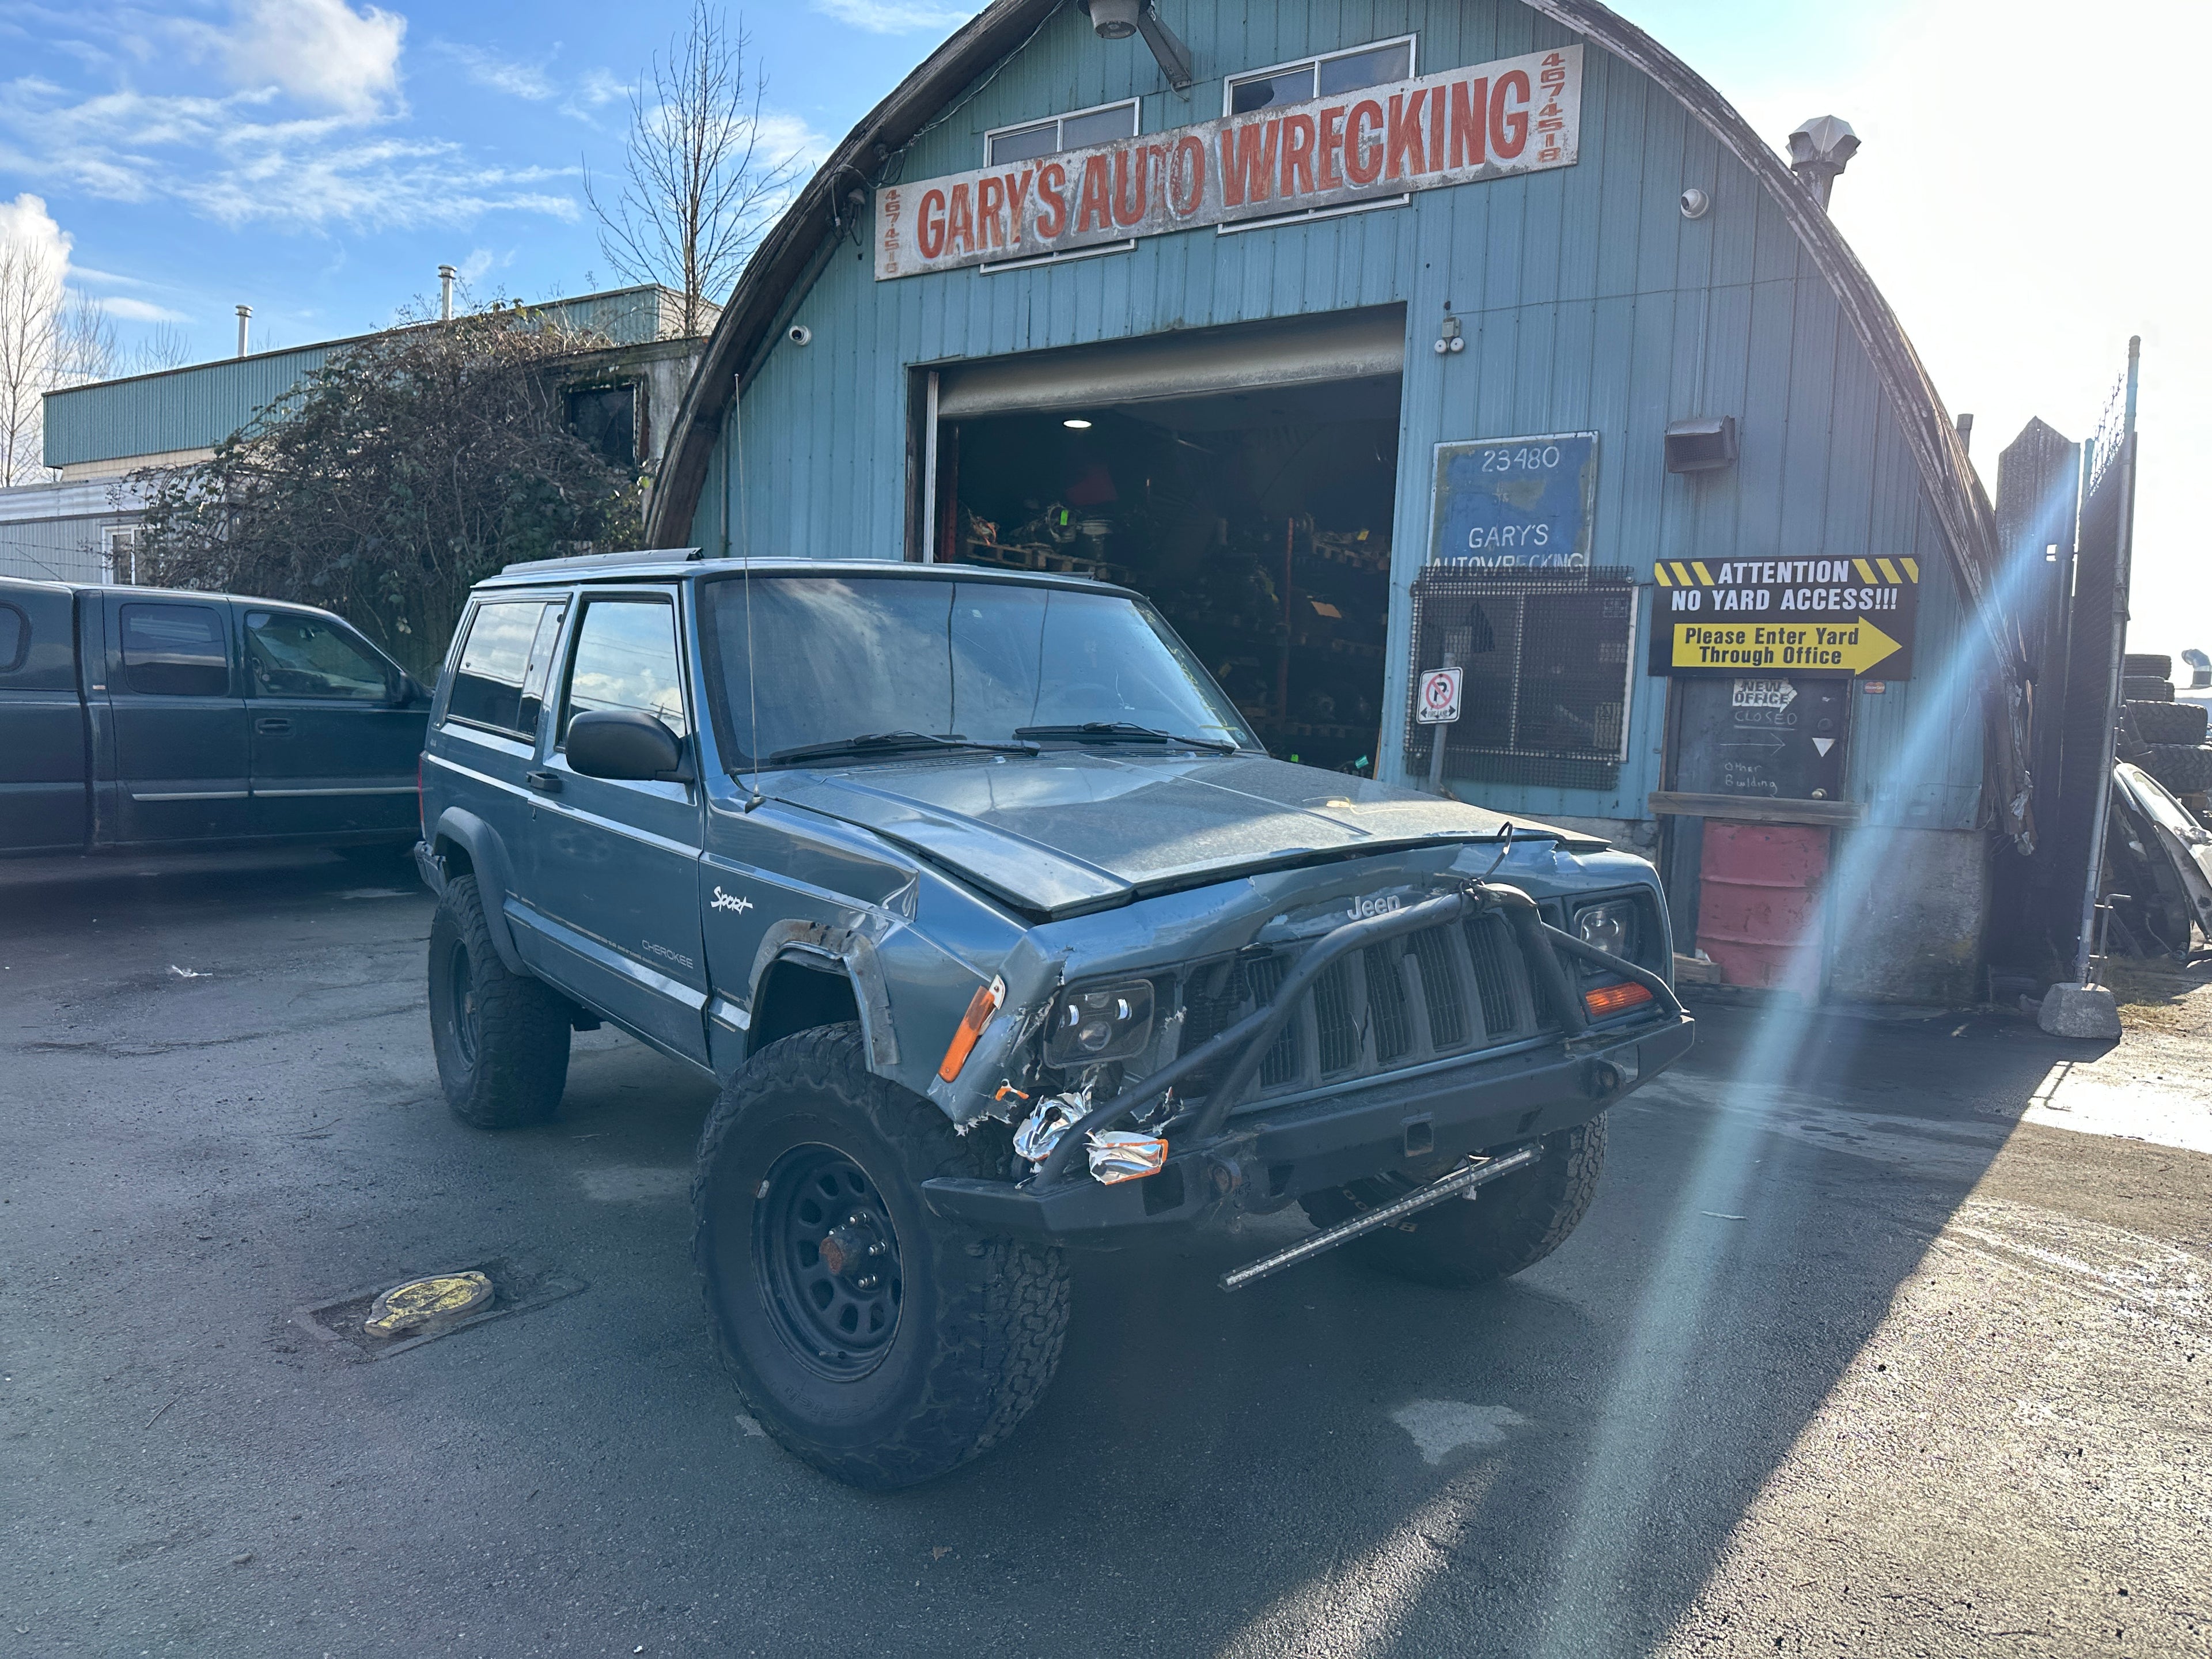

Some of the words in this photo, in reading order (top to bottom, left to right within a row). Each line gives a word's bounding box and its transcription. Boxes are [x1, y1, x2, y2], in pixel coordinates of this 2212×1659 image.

[918, 160, 1066, 259] GARY'S
[1077, 136, 1205, 231] AUTO
[1221, 70, 1530, 206] WRECKING
[1482, 446, 1560, 472] 23480
[1469, 524, 1549, 548] GARY'S
[1718, 560, 1849, 584] ATTENTION
[1672, 590, 1701, 611] NO
[1713, 589, 1770, 611] YARD
[1780, 588, 1897, 611] ACCESS!!!
[1685, 627, 1745, 644] Please
[1755, 627, 1806, 644] Enter
[1816, 627, 1859, 645] Yard
[1699, 646, 1774, 666] Through
[1783, 646, 1842, 664] Office
[1744, 680, 1779, 691] NEW
[1734, 692, 1789, 704] OFFICE
[1347, 895, 1401, 921] Jeep
[642, 940, 694, 969] CHEROKEE
